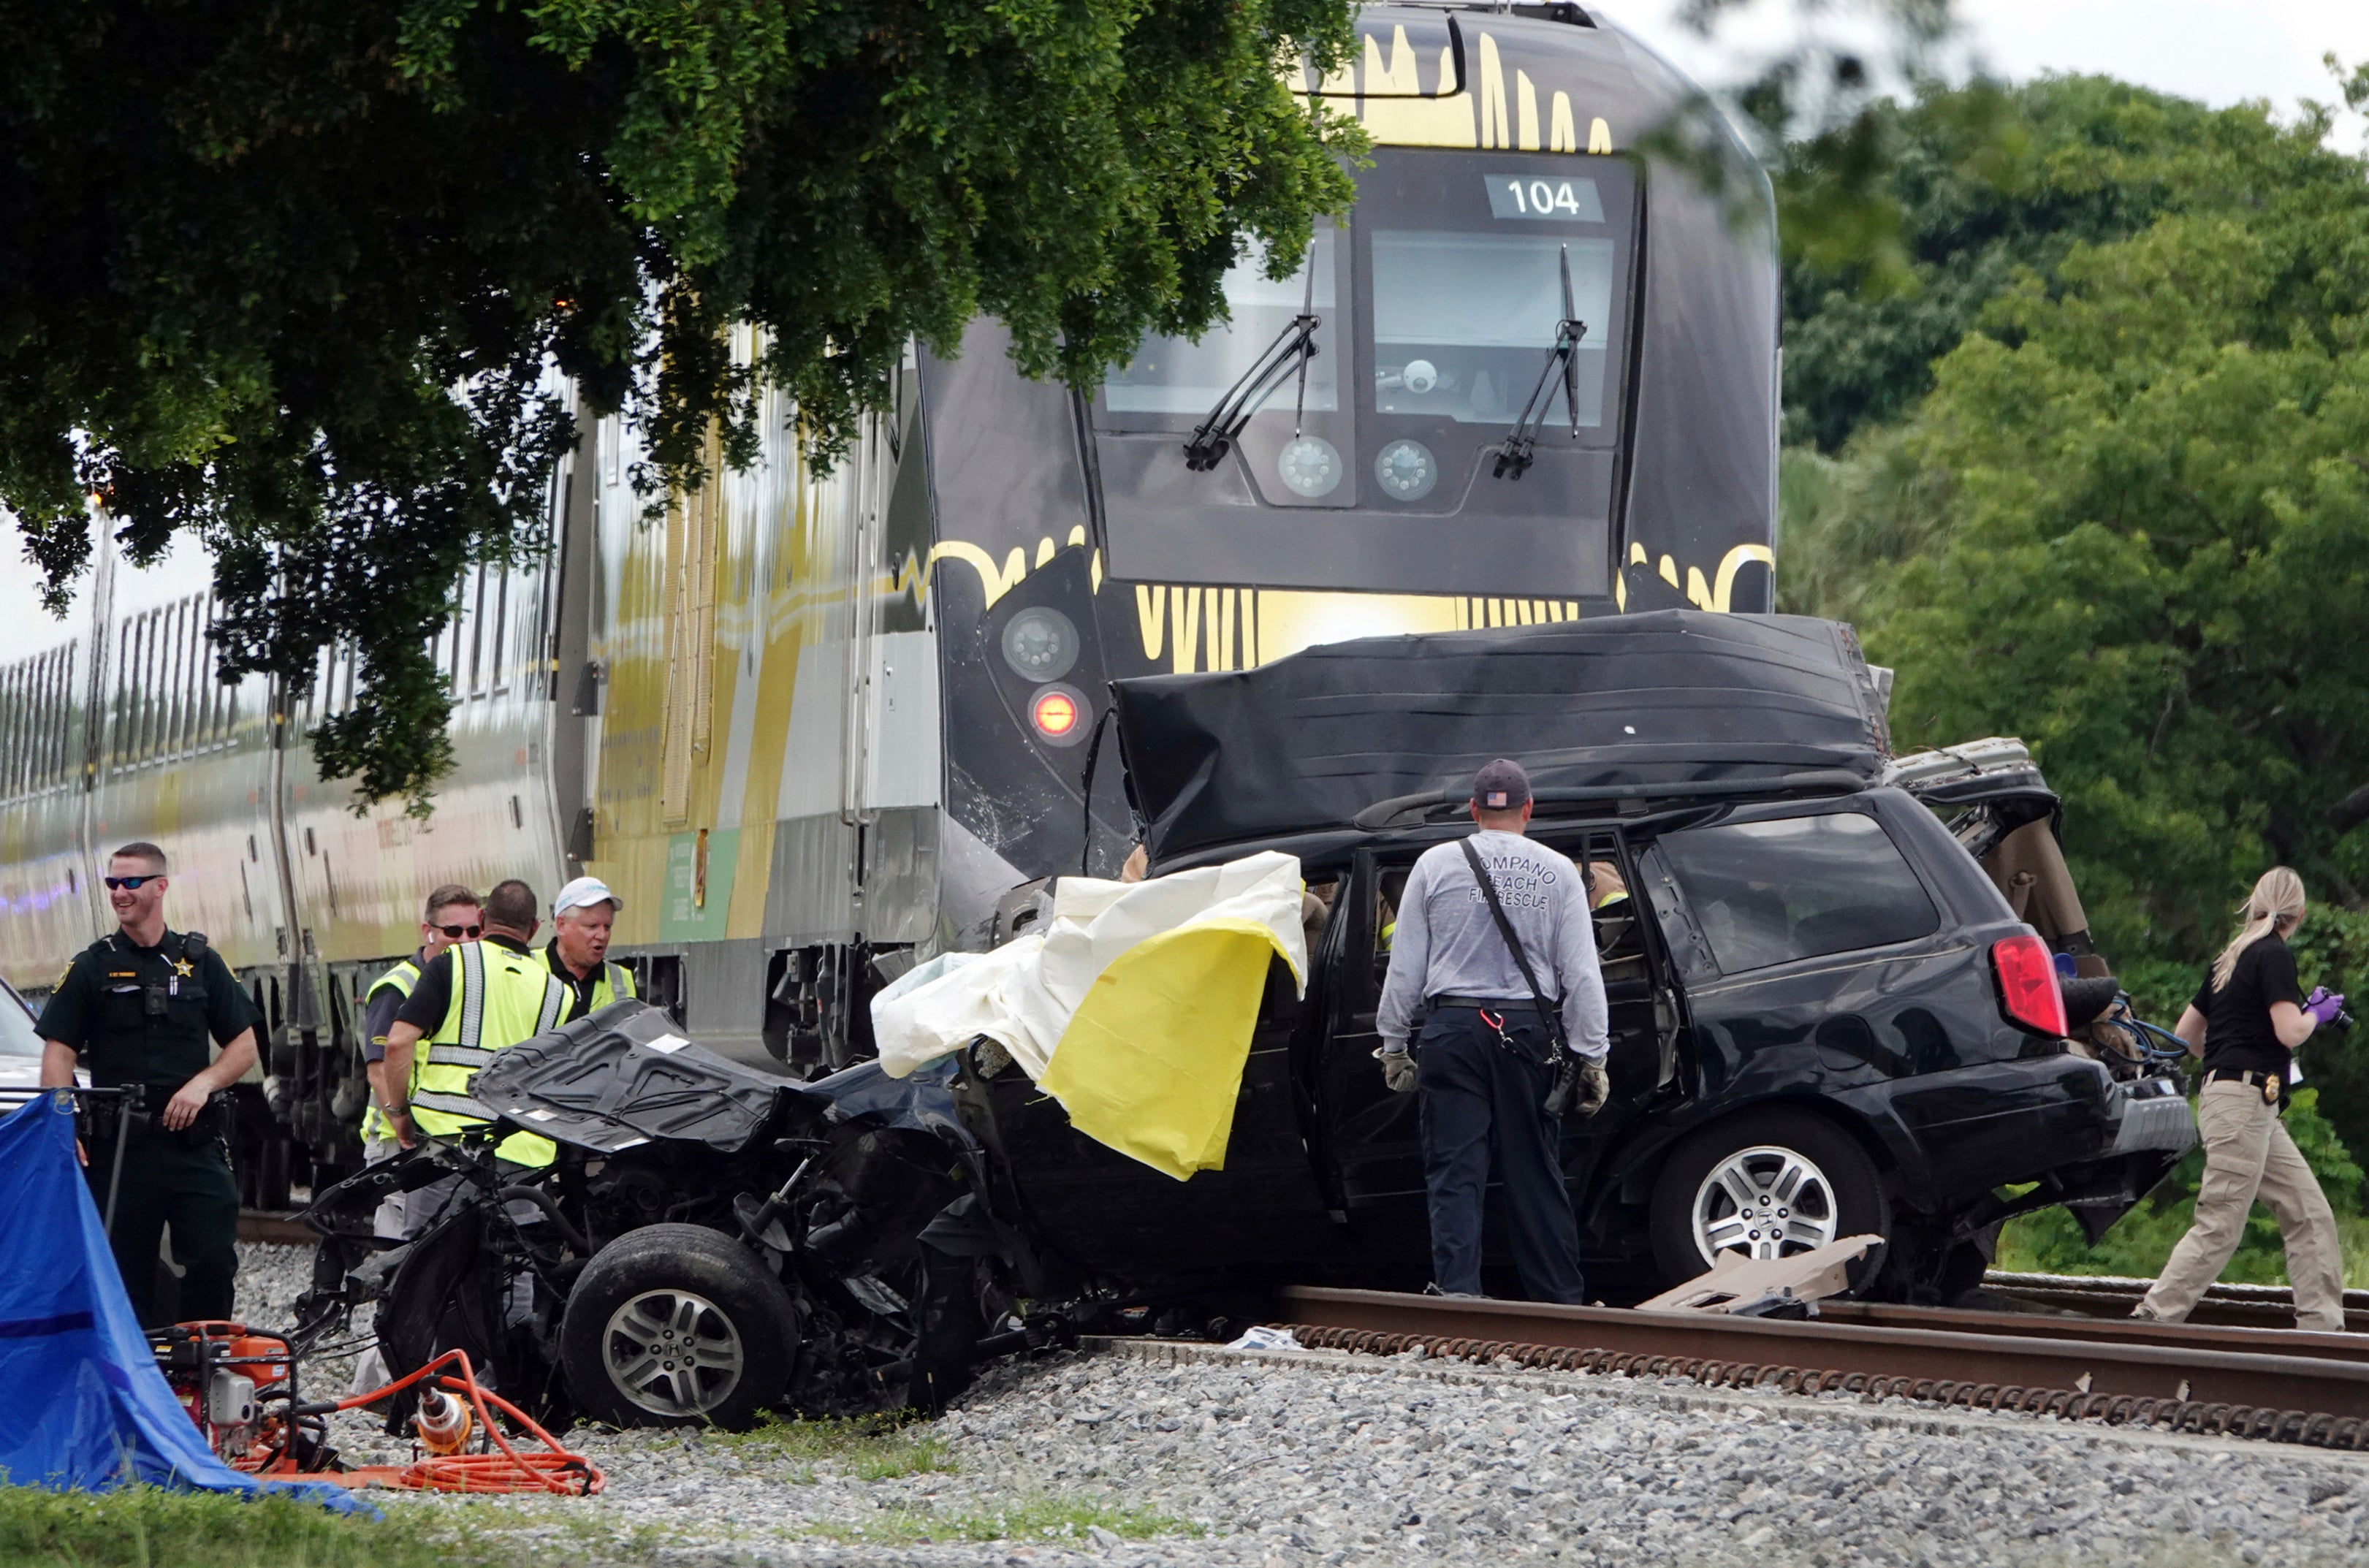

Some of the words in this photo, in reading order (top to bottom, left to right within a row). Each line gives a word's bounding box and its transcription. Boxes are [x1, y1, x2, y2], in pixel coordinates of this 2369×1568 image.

[1508, 180, 1579, 214] 104
[1468, 856, 1556, 885] OMPANO
[1486, 873, 1537, 891] EACH
